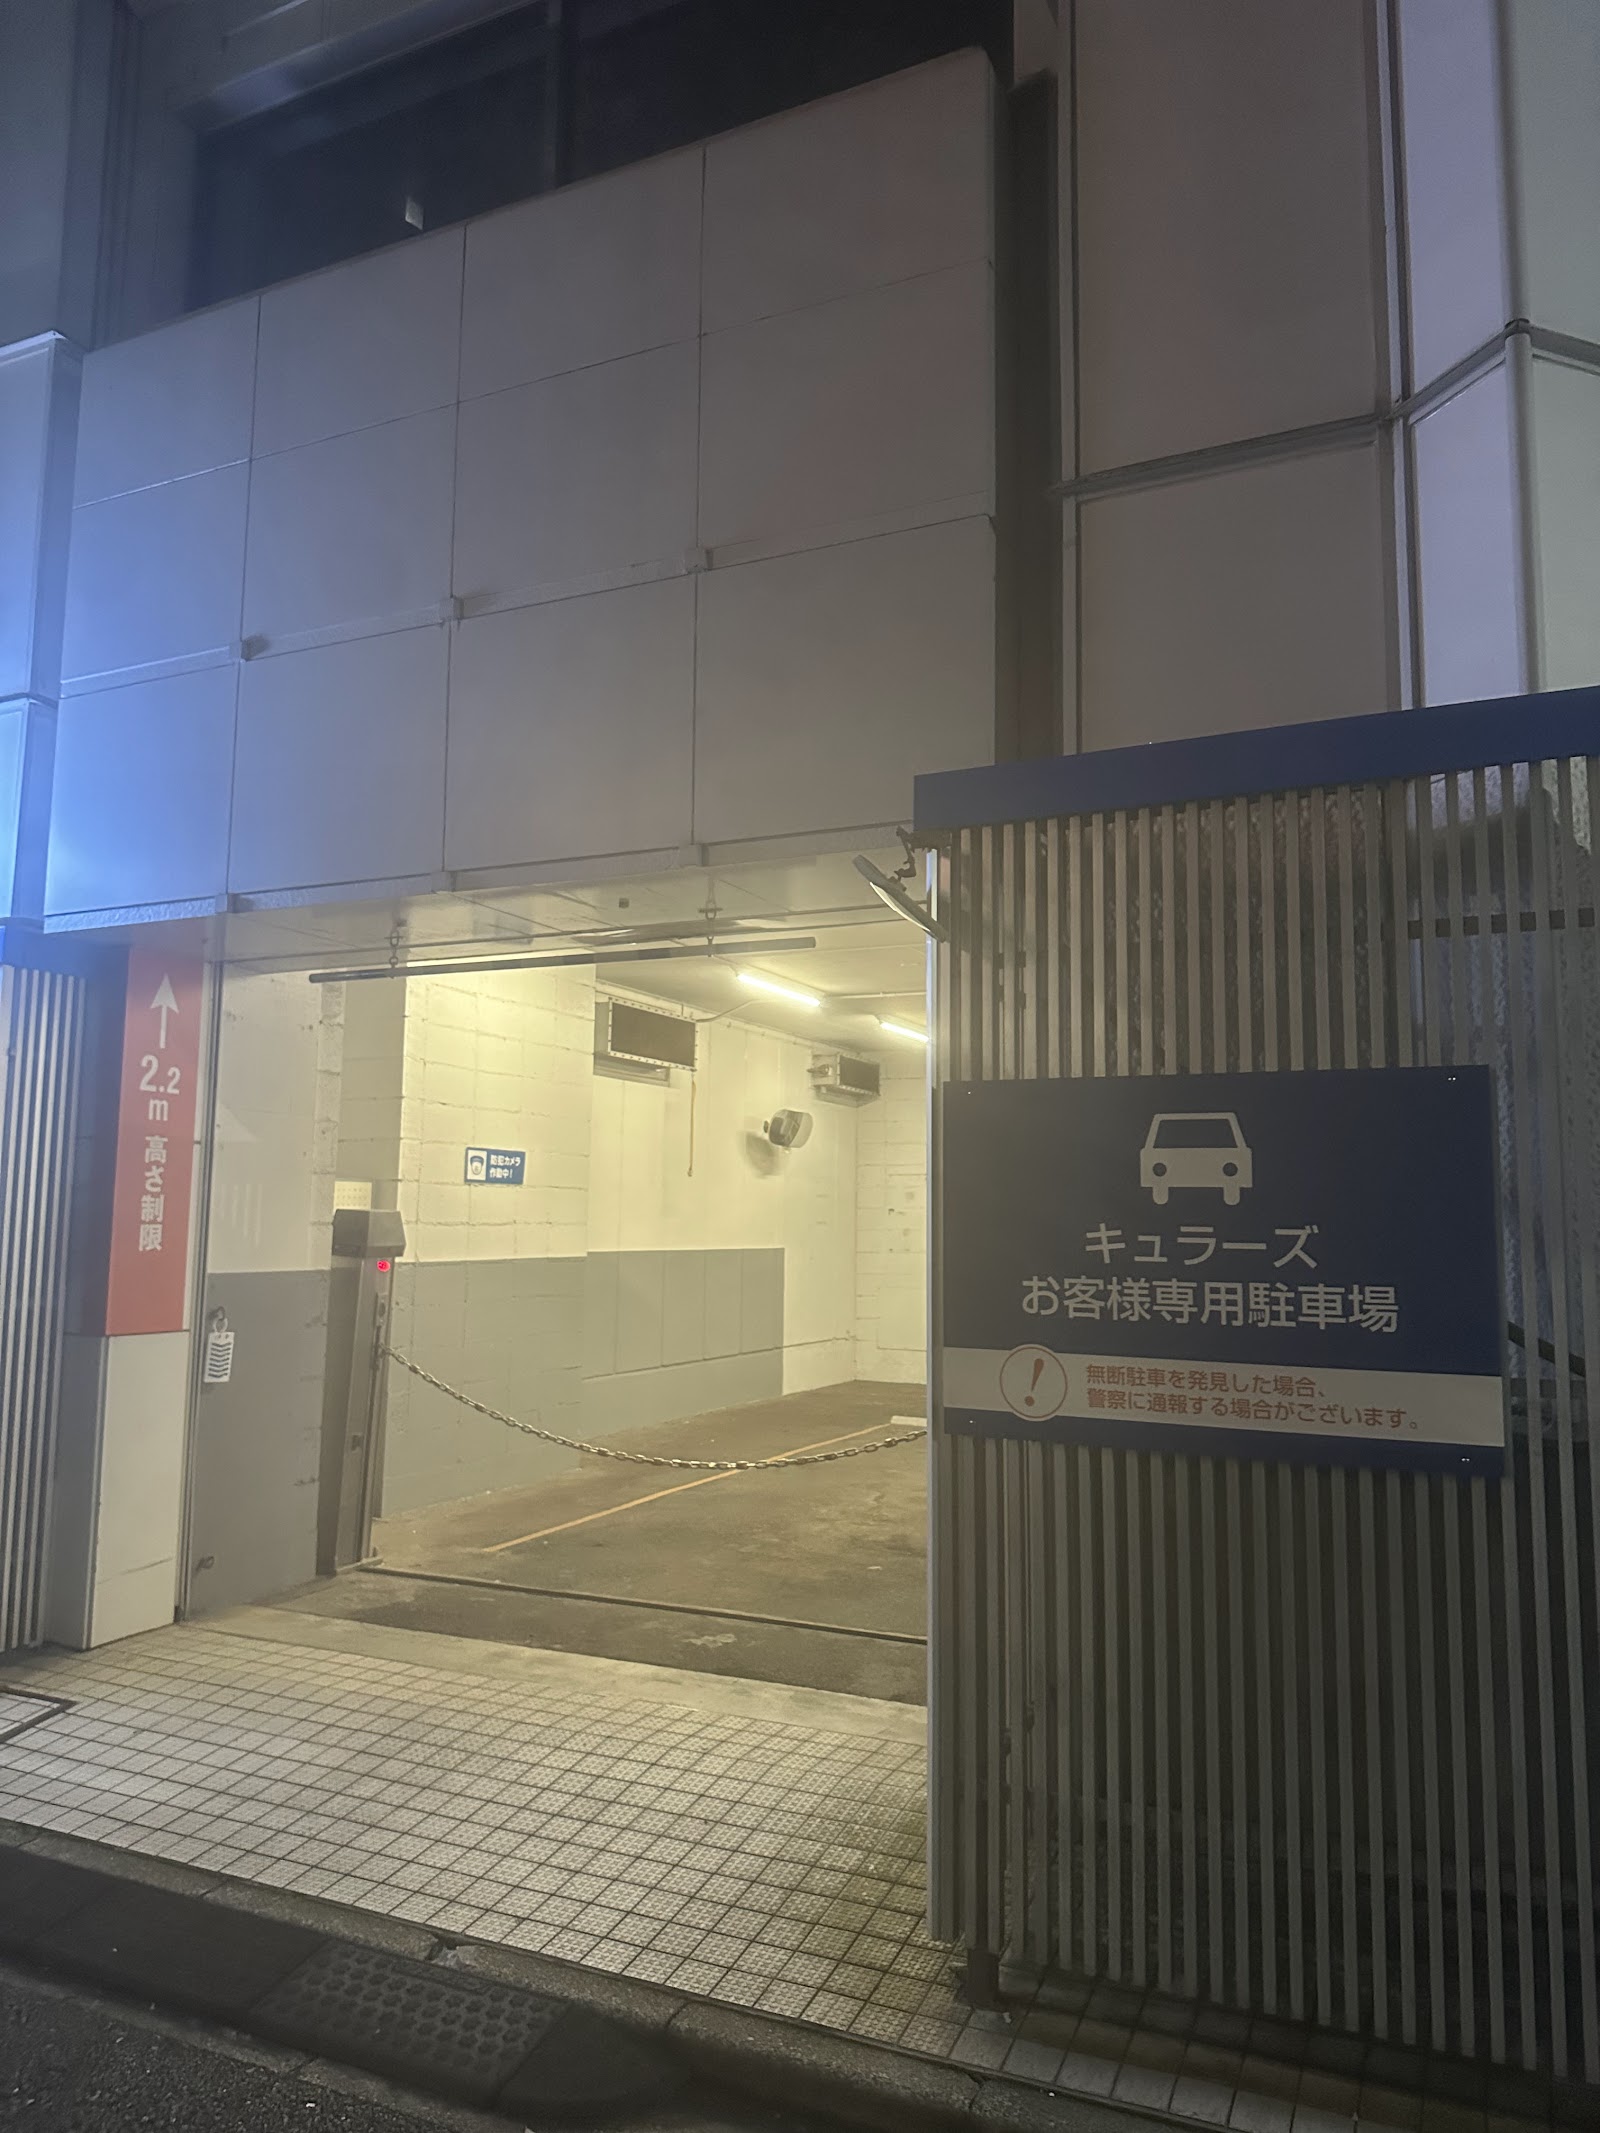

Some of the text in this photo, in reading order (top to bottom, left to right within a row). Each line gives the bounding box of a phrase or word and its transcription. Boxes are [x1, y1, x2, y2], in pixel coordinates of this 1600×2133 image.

[138, 1134, 169, 1252] 高さ制限
[1084, 1222, 1322, 1269] キュラーズ
[1021, 1275, 1400, 1334] お客様専用駐車場
[1085, 1363, 1326, 1398] 無断駐車を発見した場合、
[1086, 1387, 1419, 1430] 警察に通報する場合がございます。
